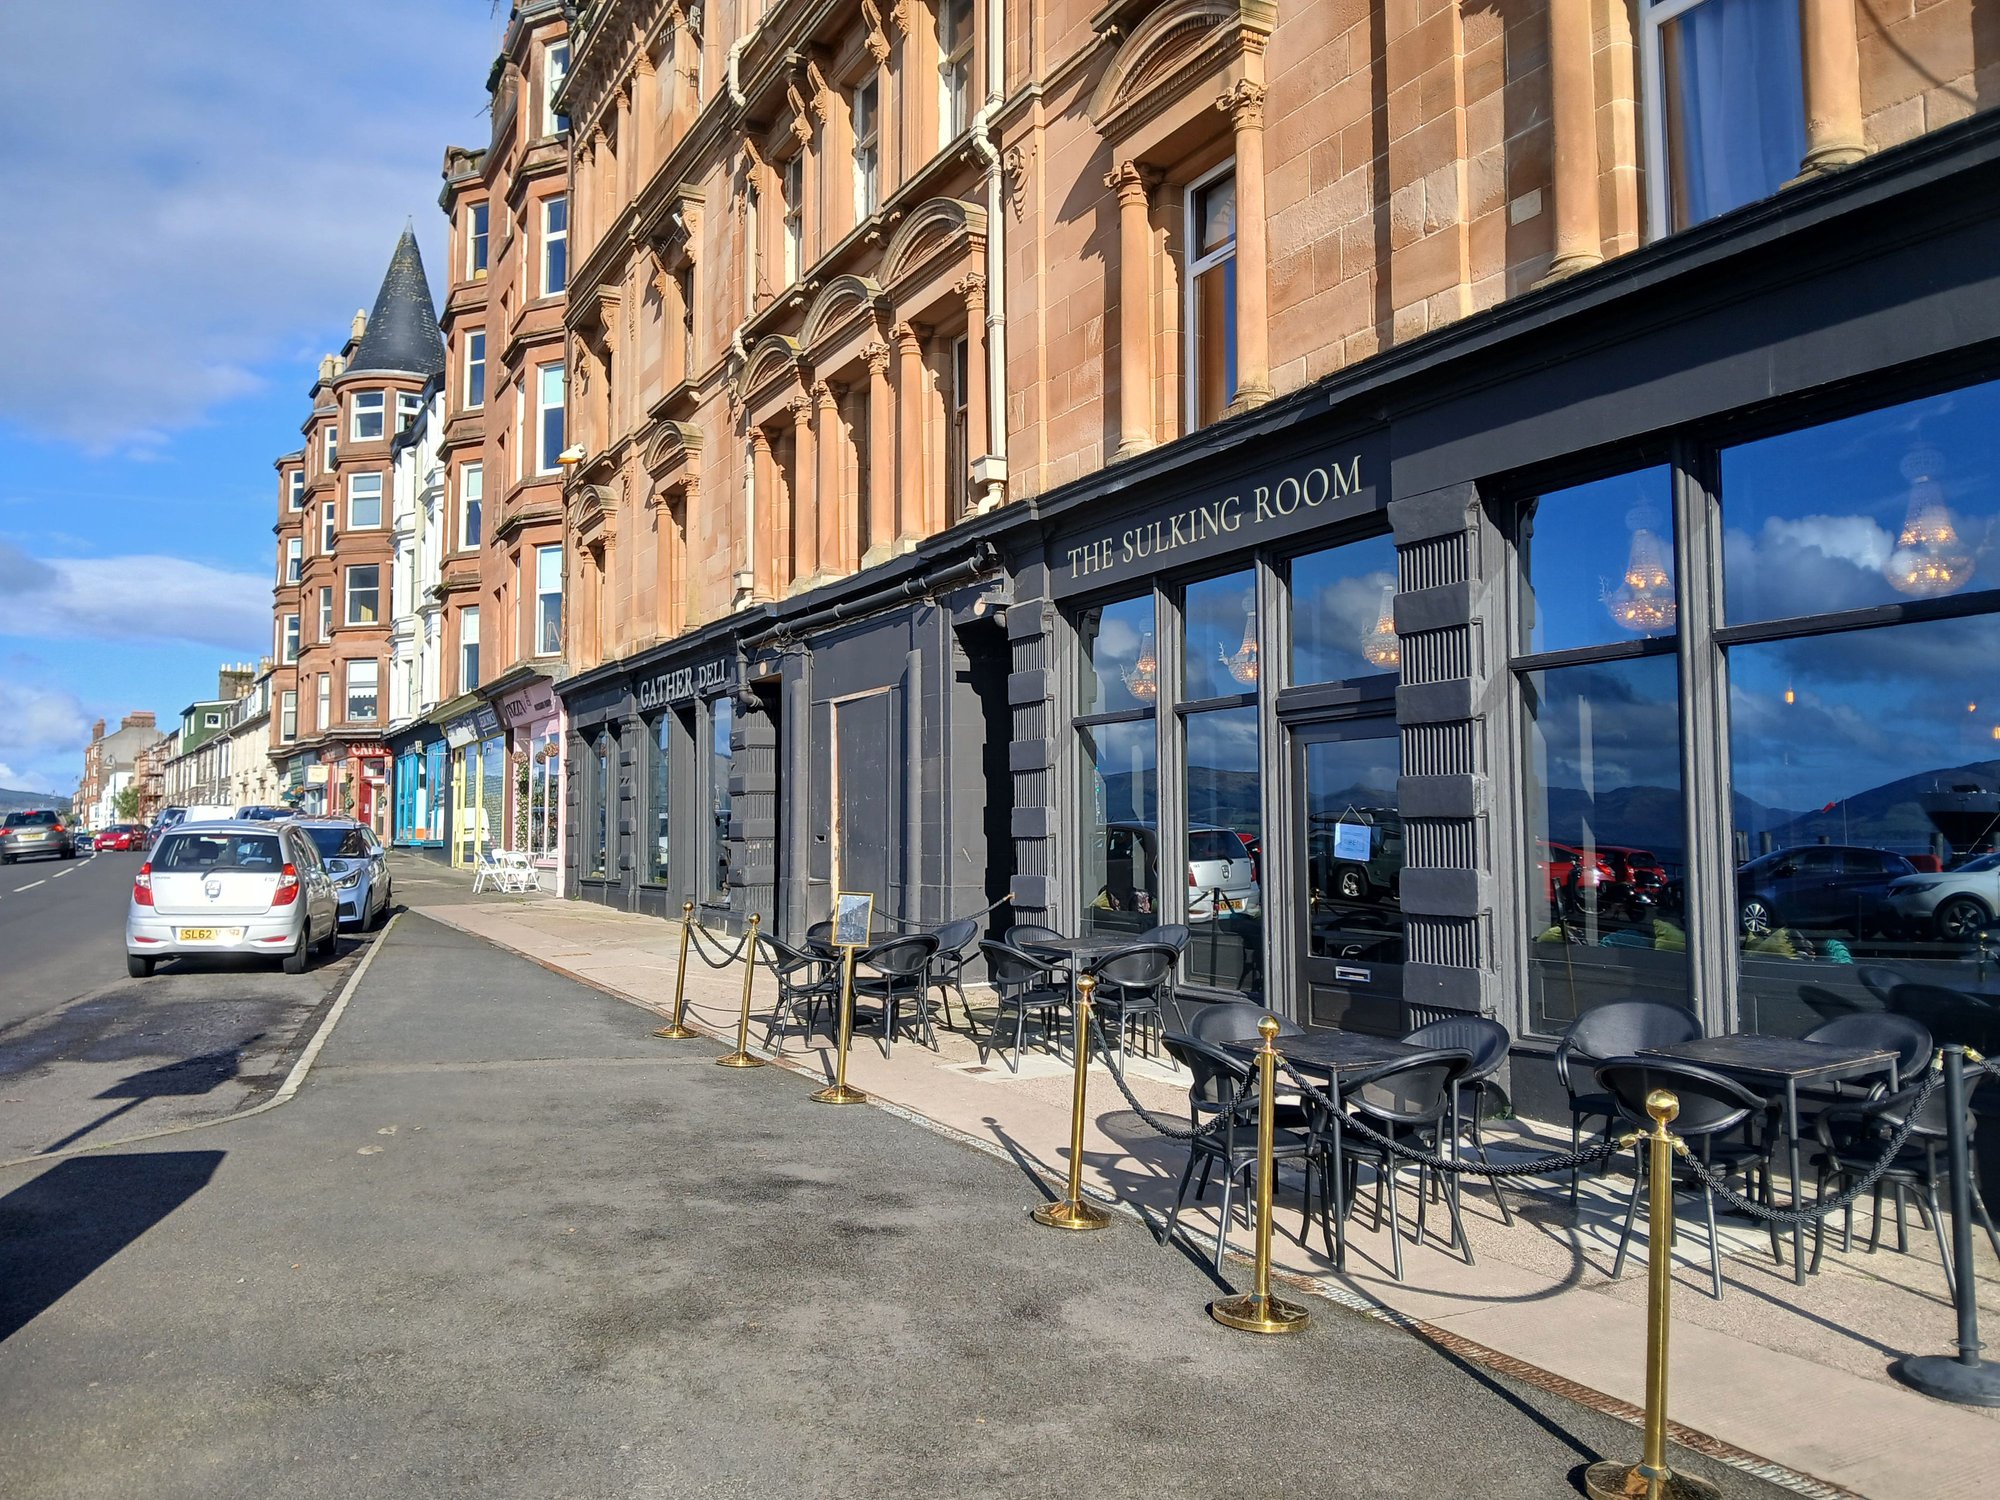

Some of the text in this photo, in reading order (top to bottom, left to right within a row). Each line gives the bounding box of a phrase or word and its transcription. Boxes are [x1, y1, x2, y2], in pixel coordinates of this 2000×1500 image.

[1067, 454, 1363, 579] THE SULKING ROOM
[640, 659, 725, 709] GATHER DELI
